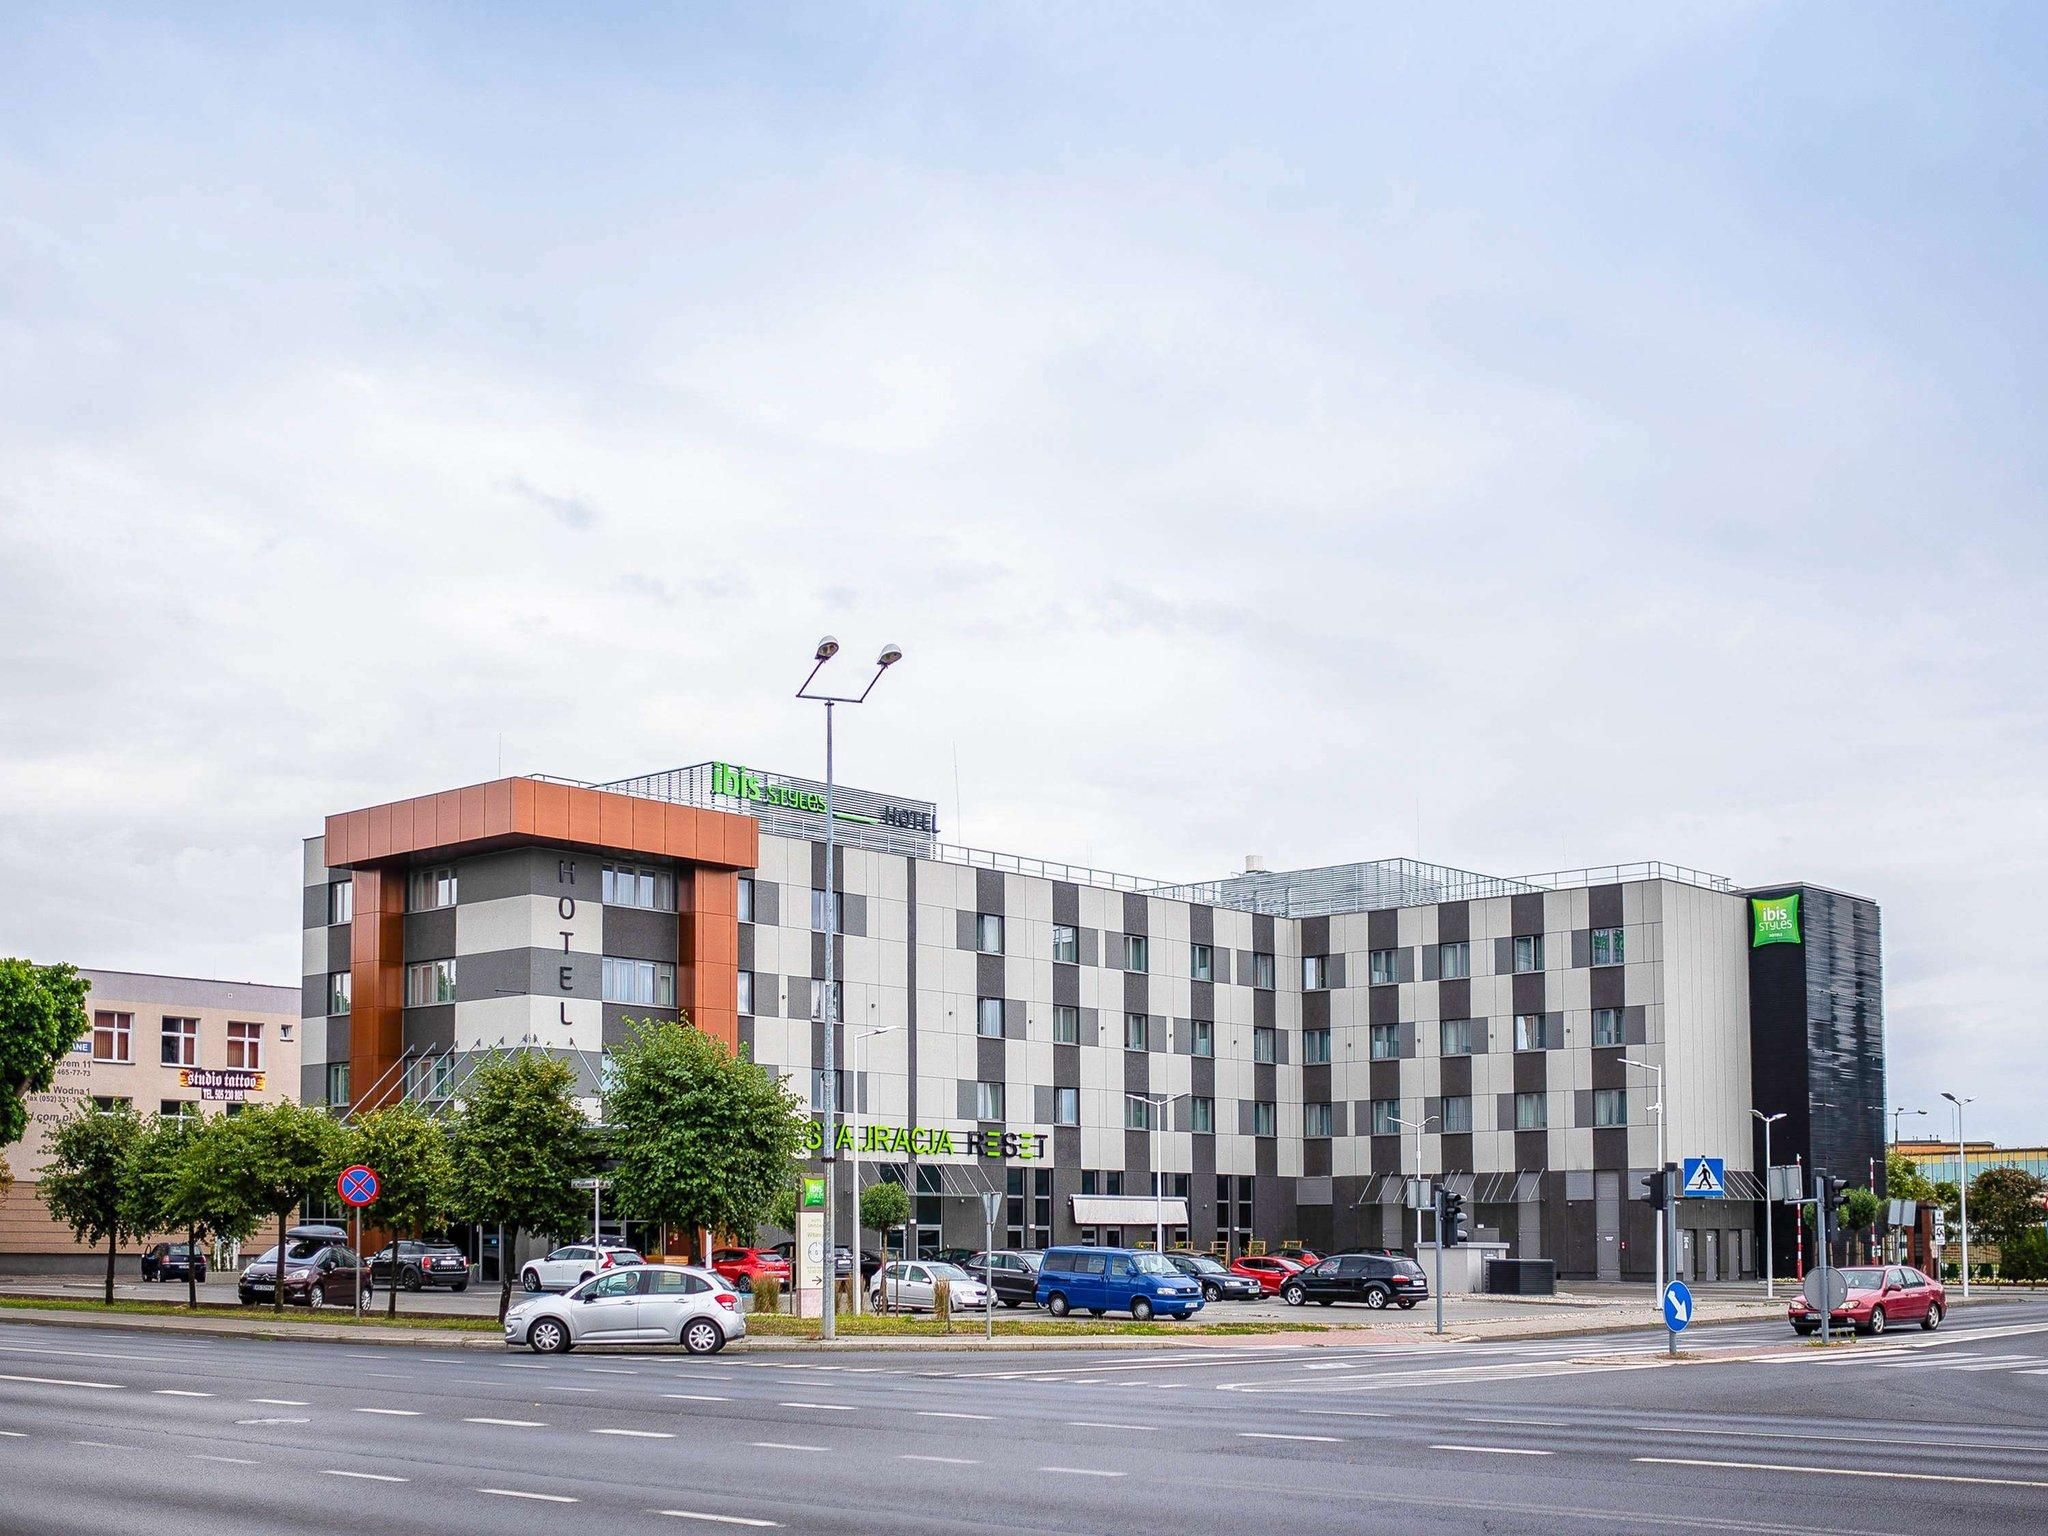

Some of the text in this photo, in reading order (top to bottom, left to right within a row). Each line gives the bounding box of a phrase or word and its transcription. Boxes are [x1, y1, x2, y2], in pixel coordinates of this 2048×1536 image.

[713, 762, 760, 800] ibis
[1762, 906, 1788, 922] ibis
[558, 860, 576, 1026] HOTEL
[82, 1060, 91, 1068] 11
[188, 1071, 256, 1088] studio tattoo
[26, 1094, 38, 1102] fax
[53, 1086, 84, 1095] Wodna
[967, 1130, 1048, 1158] RESET
